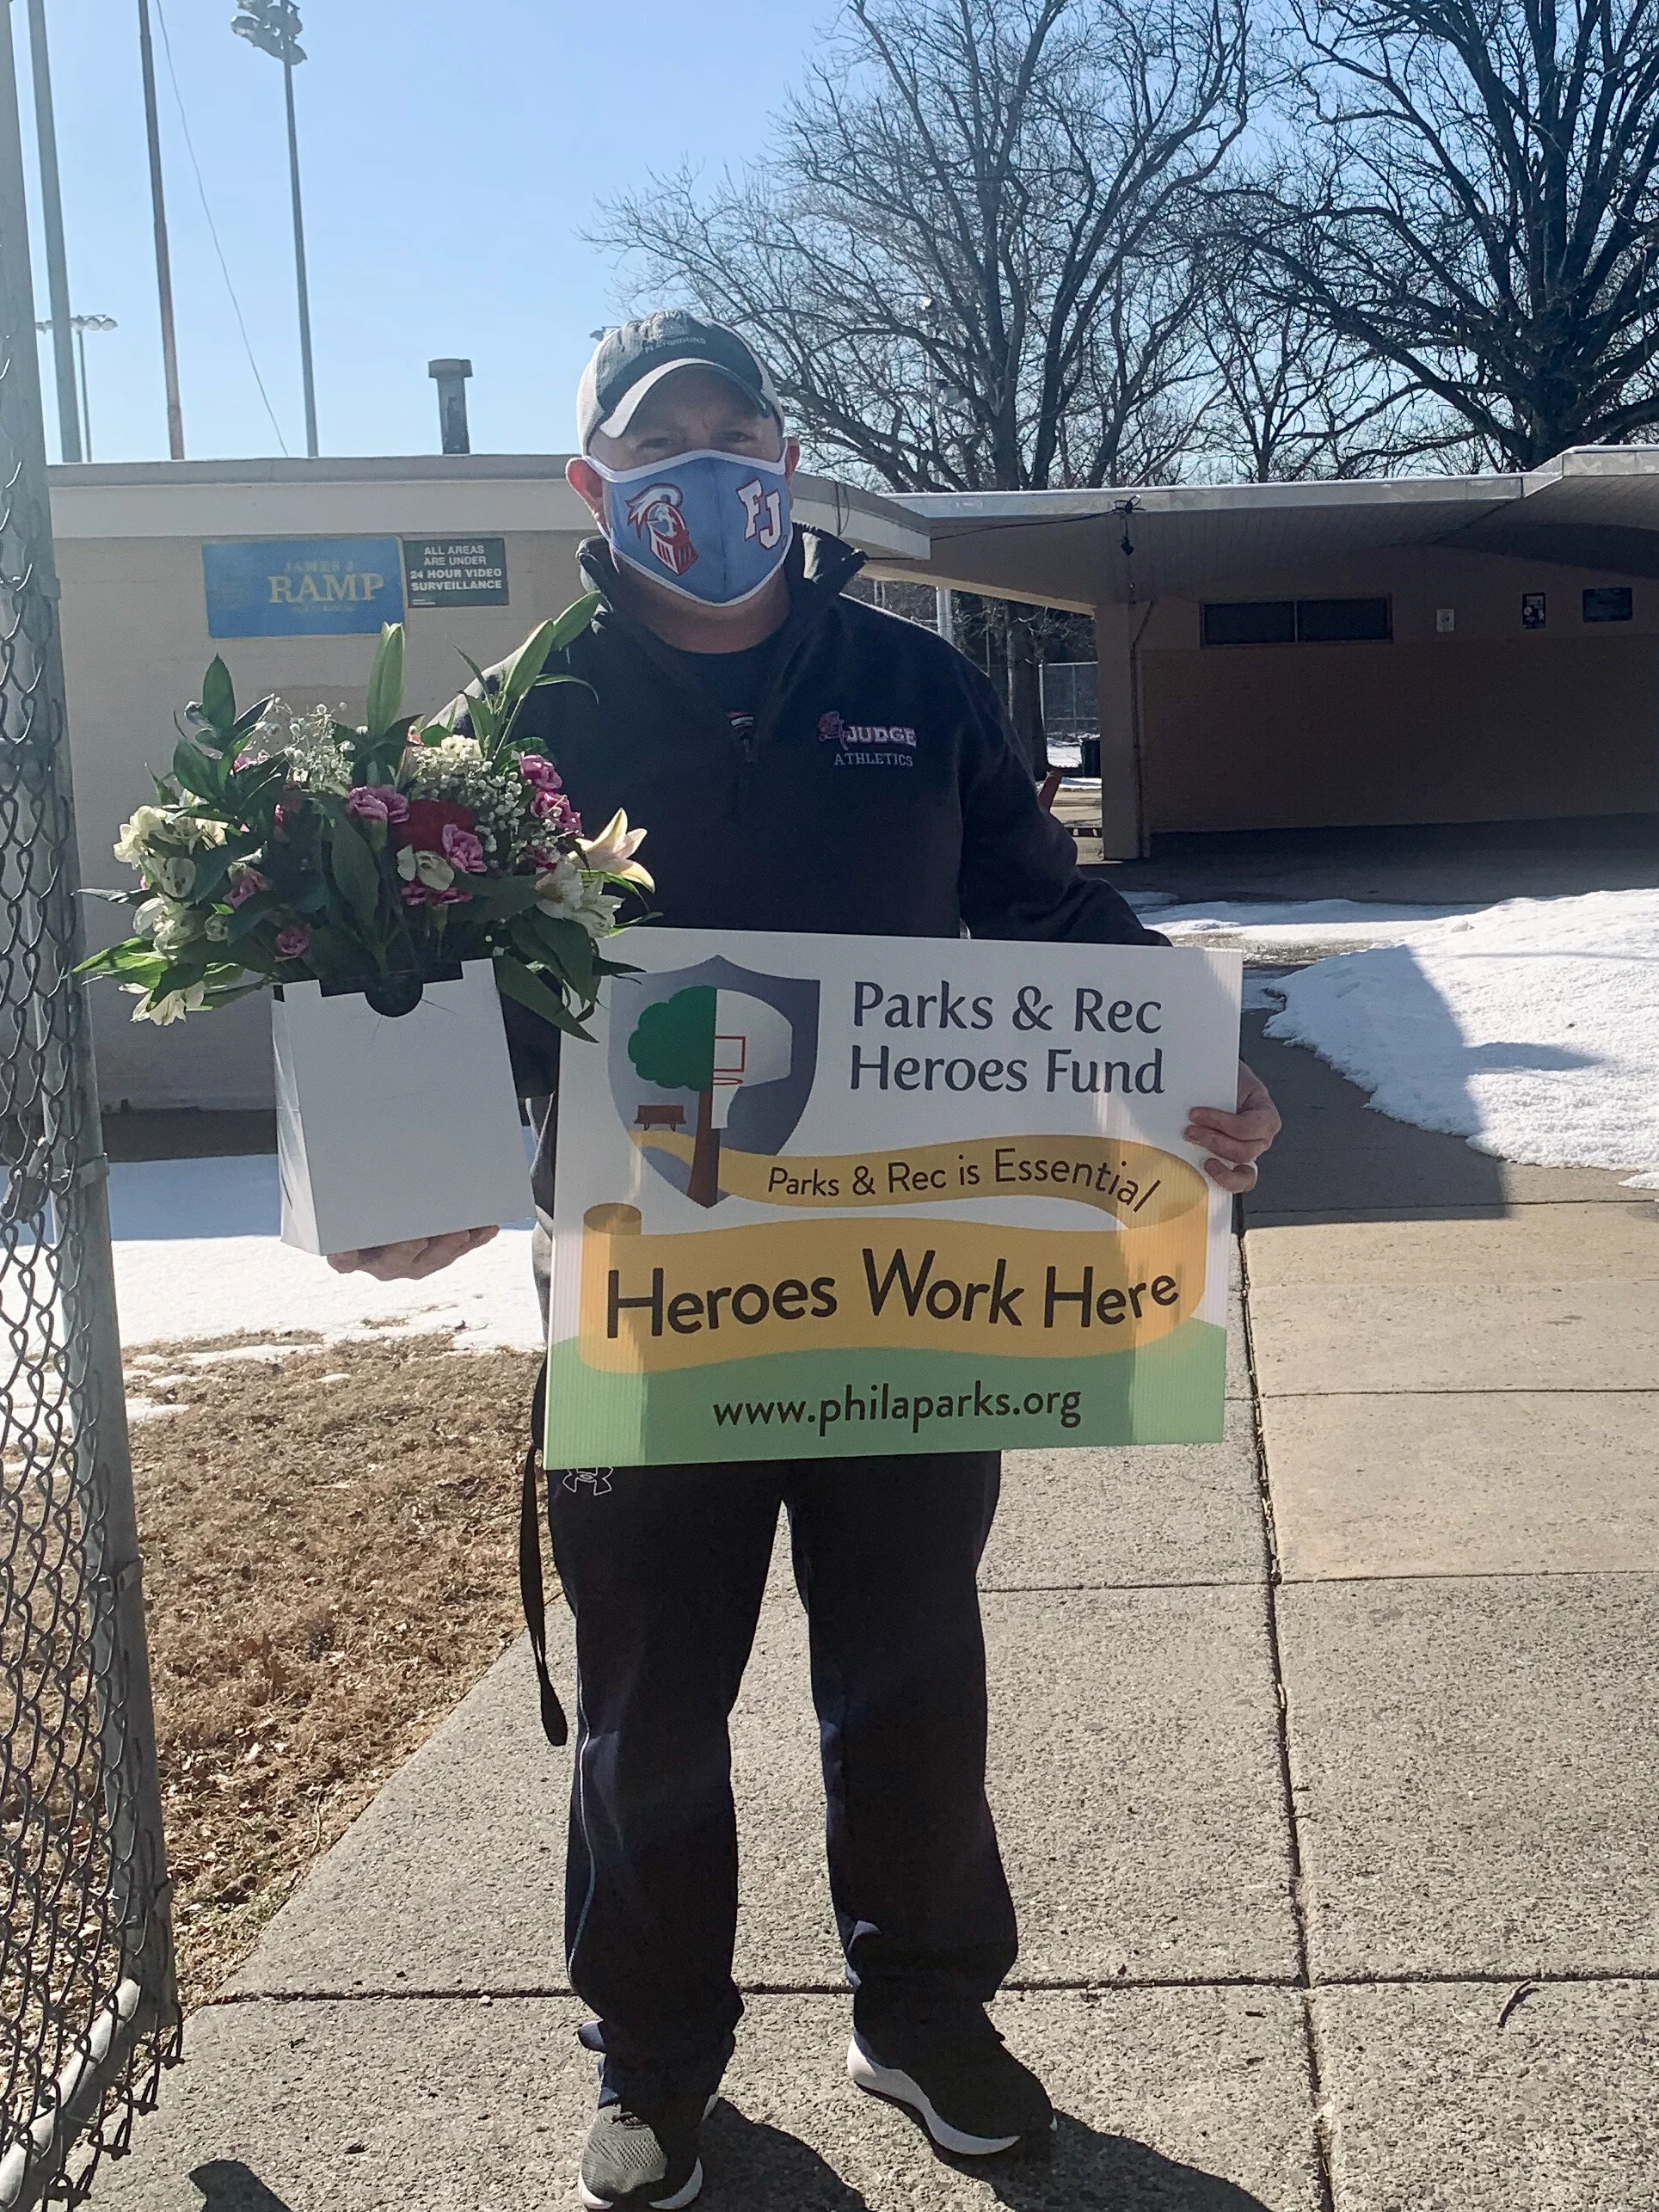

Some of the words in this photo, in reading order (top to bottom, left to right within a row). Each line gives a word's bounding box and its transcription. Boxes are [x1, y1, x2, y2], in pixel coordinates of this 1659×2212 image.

[735, 477, 783, 550] FJ
[423, 545, 445, 556] ALL
[447, 544, 485, 555] AREAS
[423, 556, 446, 566] ARE
[448, 556, 487, 566] UNDER
[267, 572, 385, 603] RAMP
[409, 569, 424, 580] 24
[427, 568, 462, 579] HOUR
[465, 568, 503, 578] VIDEO
[411, 580, 503, 592] SURVEILLANCE
[846, 726, 917, 747] JUDGE
[833, 753, 913, 767] ATHLETICS
[853, 980, 994, 1030] Parks
[1012, 986, 1054, 1031] &
[1074, 987, 1163, 1034] Rec
[850, 1044, 1029, 1092] Heroes
[1046, 1048, 1166, 1094] Fund
[767, 1166, 840, 1197] Parks
[851, 1165, 876, 1195] &
[888, 1161, 947, 1193] Rec
[958, 1154, 981, 1186] is
[994, 1147, 1162, 1214] Essential
[606, 1267, 839, 1339] Heroes
[862, 1247, 1026, 1327] Work
[1043, 1265, 1181, 1329] Here
[712, 1379, 1083, 1436] www.philaparks.org
